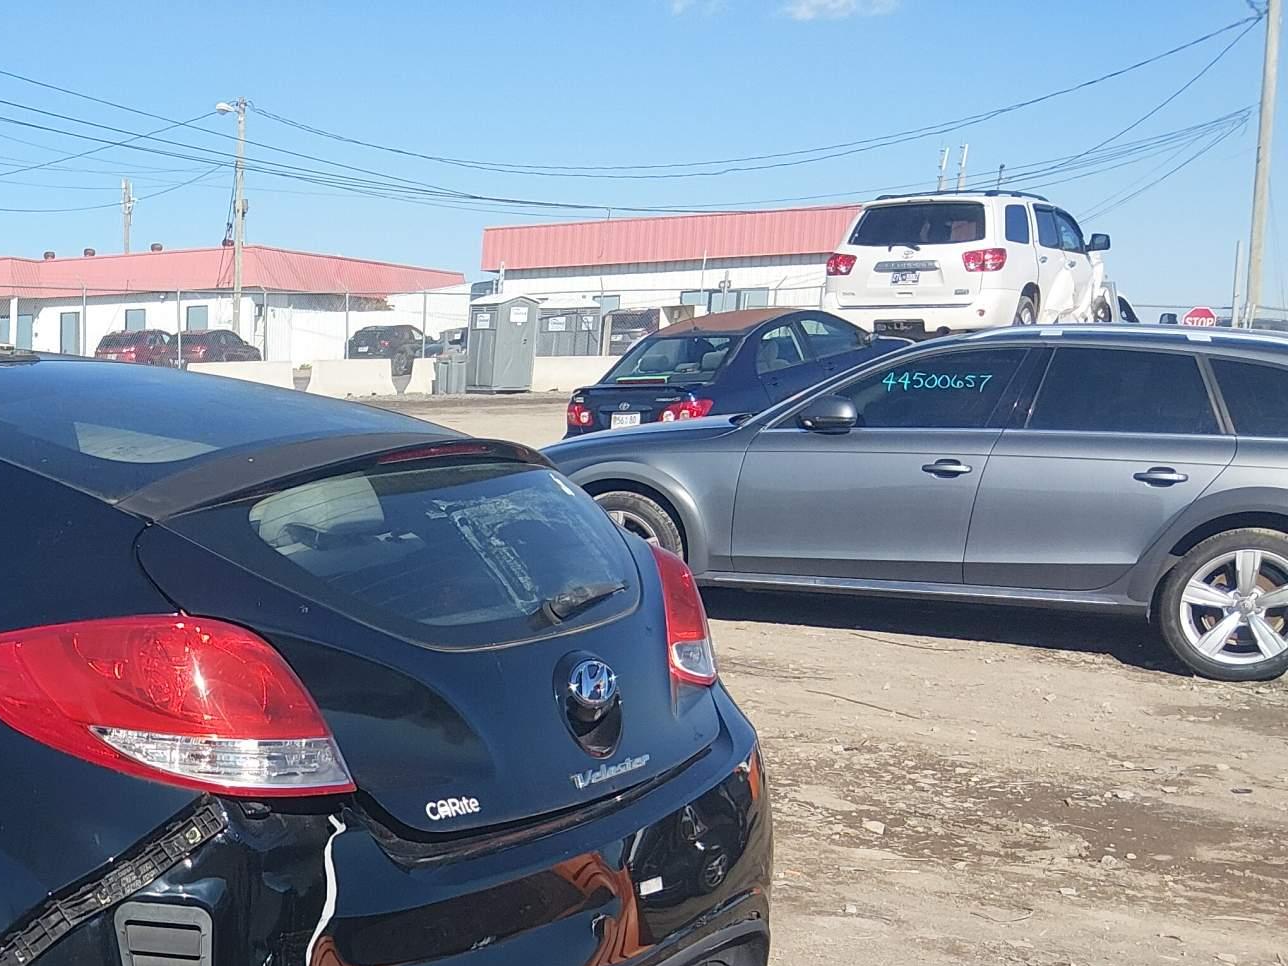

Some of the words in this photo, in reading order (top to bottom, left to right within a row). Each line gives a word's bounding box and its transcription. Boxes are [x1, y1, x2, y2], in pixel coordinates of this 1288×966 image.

[1185, 316, 1214, 327] STOP
[882, 371, 993, 393] 44500657
[570, 753, 650, 790] Veloster
[425, 796, 481, 820] CARite
